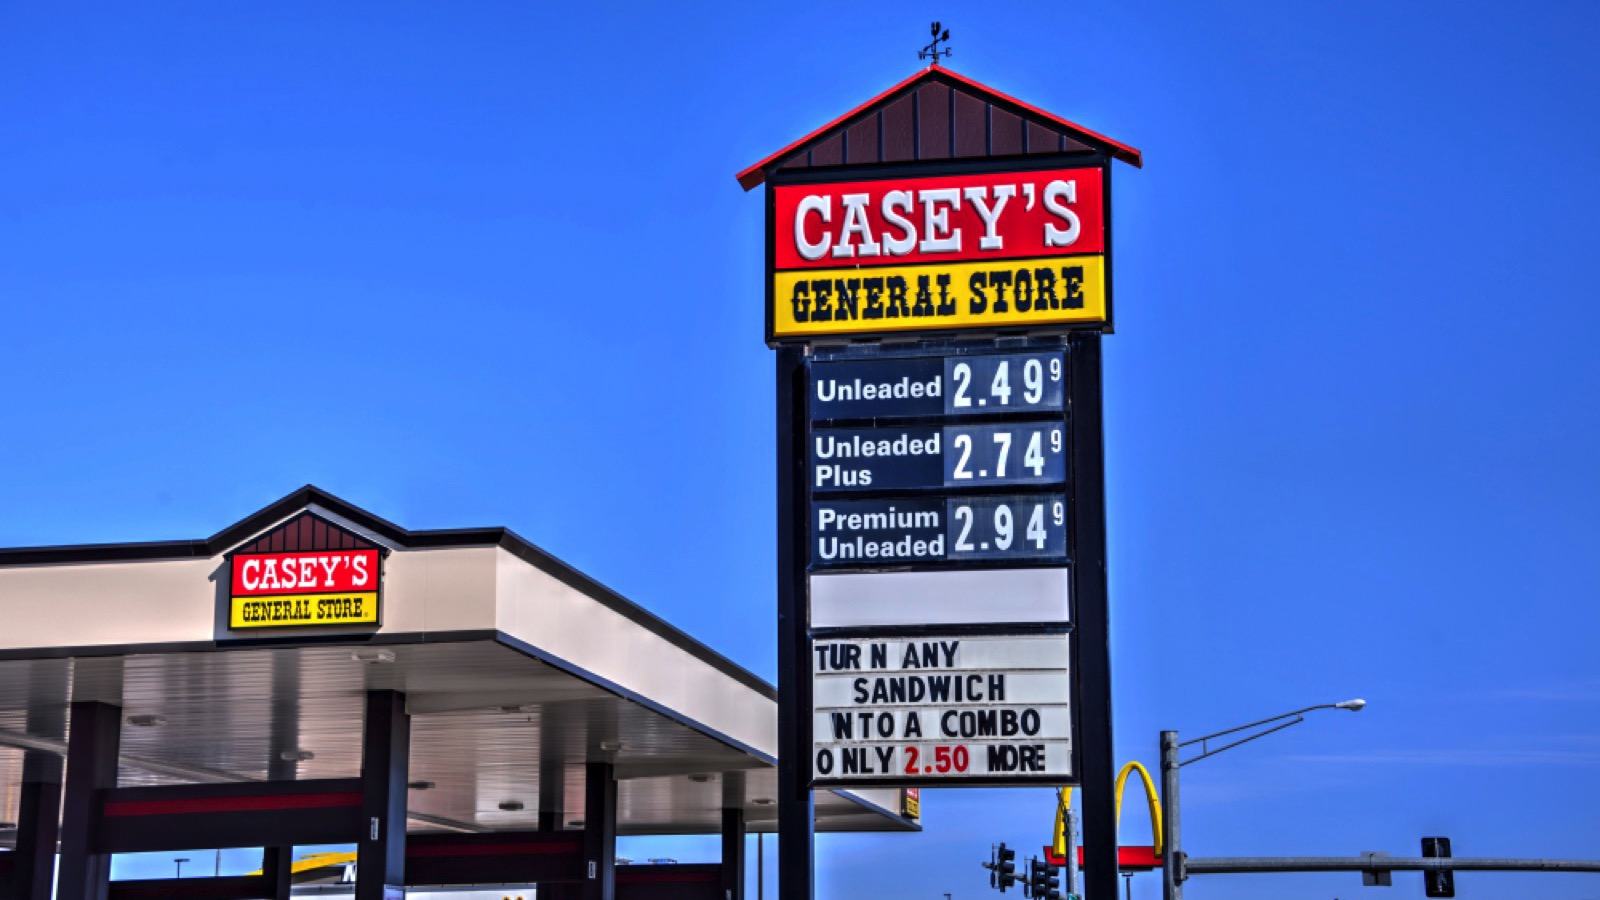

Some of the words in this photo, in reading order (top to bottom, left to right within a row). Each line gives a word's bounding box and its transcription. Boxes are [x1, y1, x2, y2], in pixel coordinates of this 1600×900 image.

[794, 179, 1081, 261] CASEY'S
[791, 273, 957, 323] GENERAL
[968, 266, 1085, 315] STORE
[817, 375, 942, 402] Unleaded
[815, 432, 940, 459] Unleaded
[815, 465, 872, 487] Plus
[818, 506, 939, 531] Premium
[818, 534, 945, 560] Unleaded
[241, 554, 369, 591] CASEY'S
[242, 600, 312, 622] GENERAL
[316, 598, 363, 620] STORE
[815, 642, 888, 671] TURN
[902, 641, 960, 669] ANY
[853, 674, 1005, 704] SANDWICH
[904, 711, 923, 738] A
[941, 708, 1041, 738] COMBO
[904, 744, 970, 775] 2.50
[988, 744, 1046, 772] MORE
